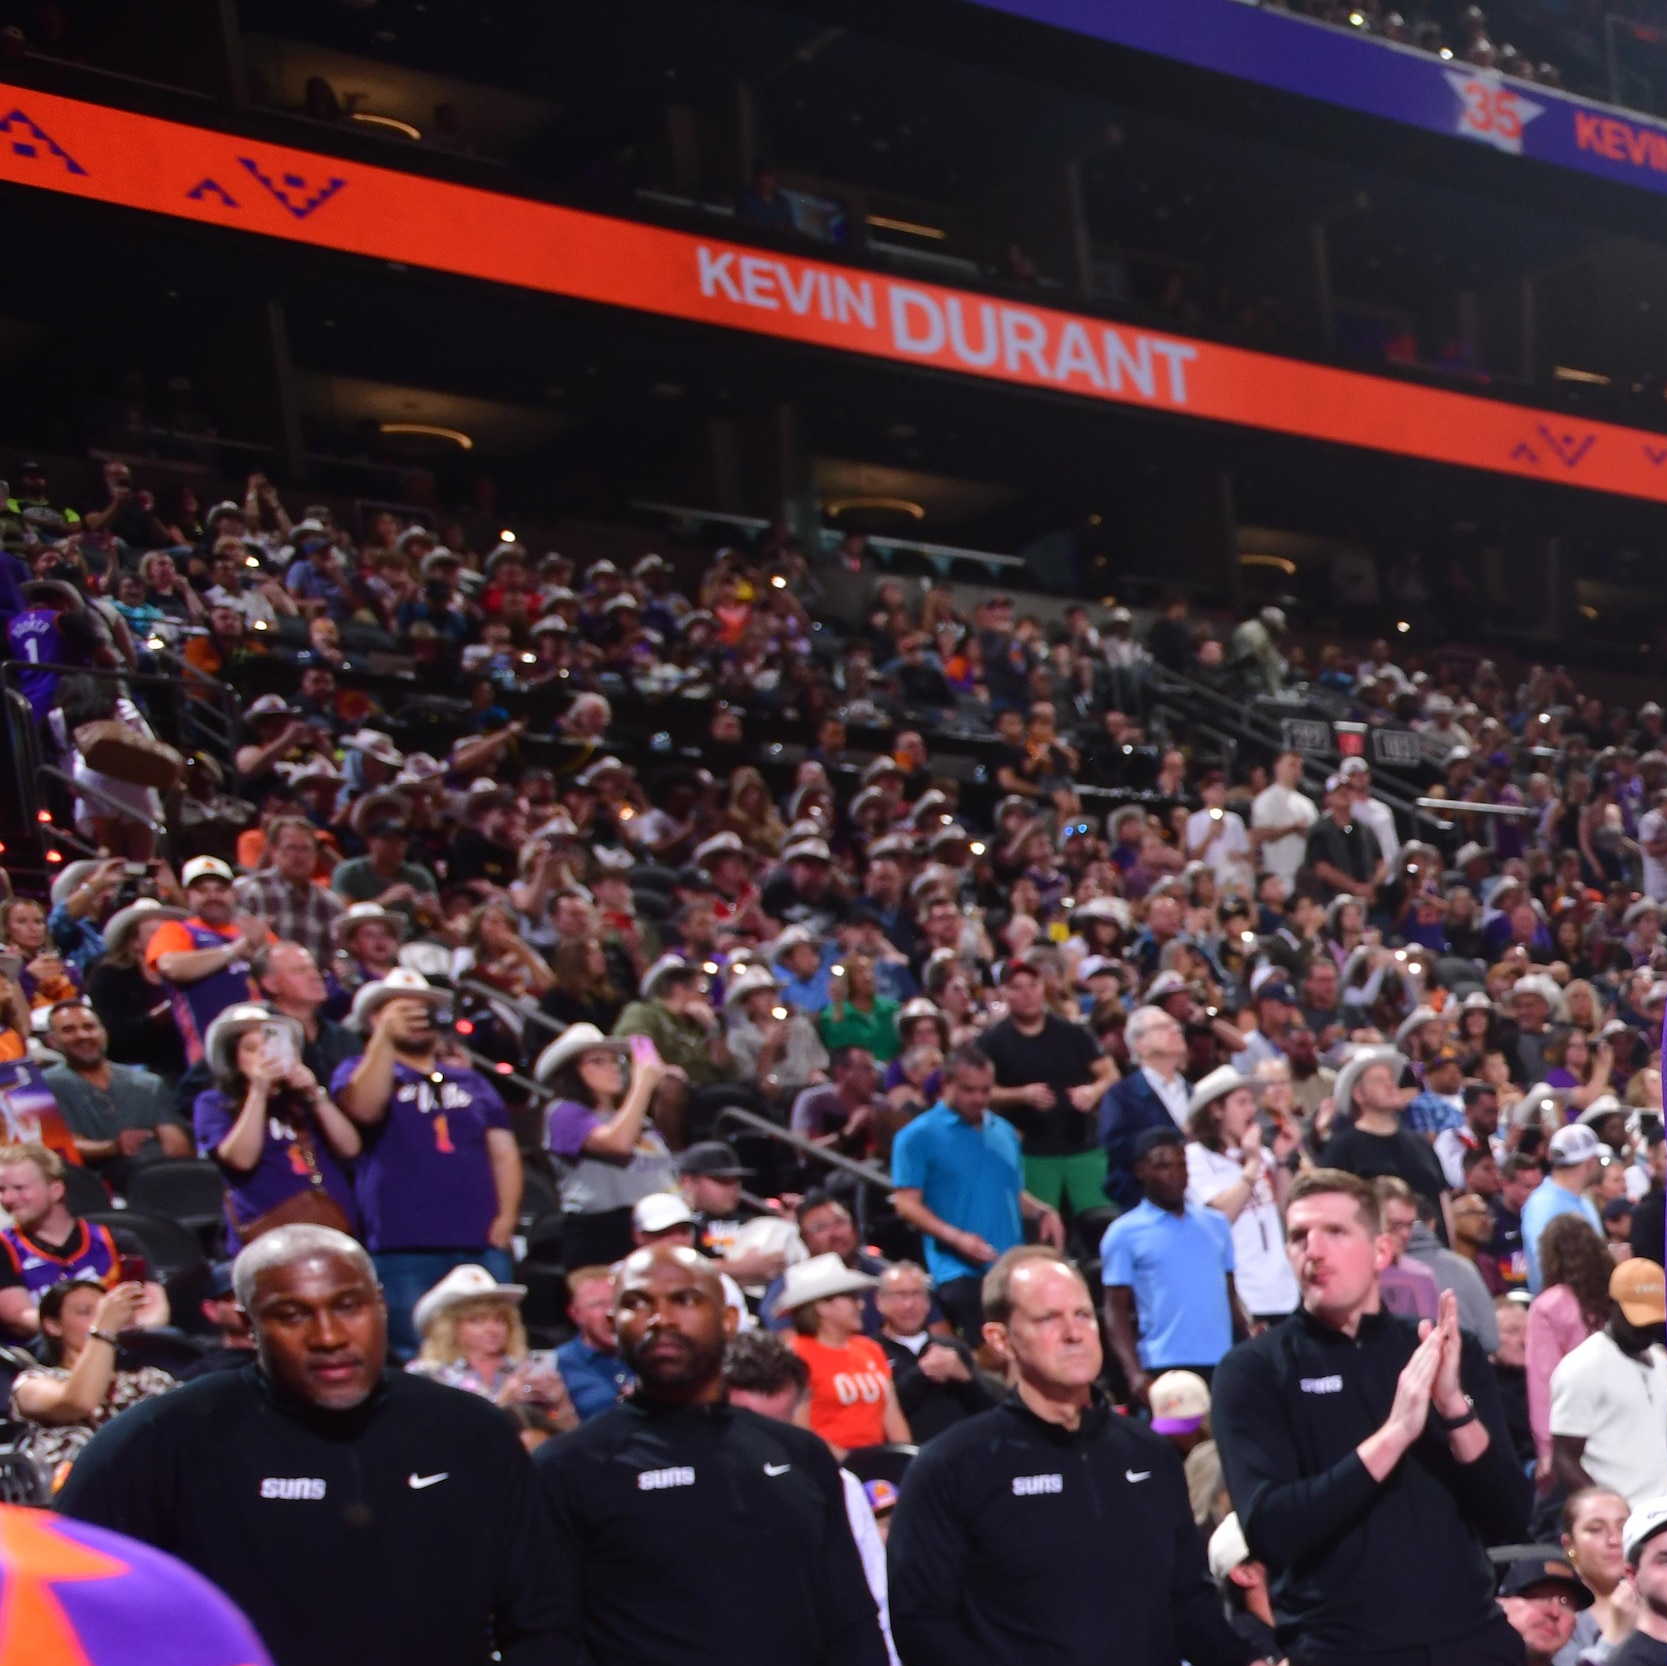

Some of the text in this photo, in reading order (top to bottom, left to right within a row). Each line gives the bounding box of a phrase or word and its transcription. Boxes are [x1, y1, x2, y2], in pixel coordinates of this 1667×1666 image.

[1464, 80, 1524, 139] 35
[696, 247, 1197, 404] KEVIN DURANT
